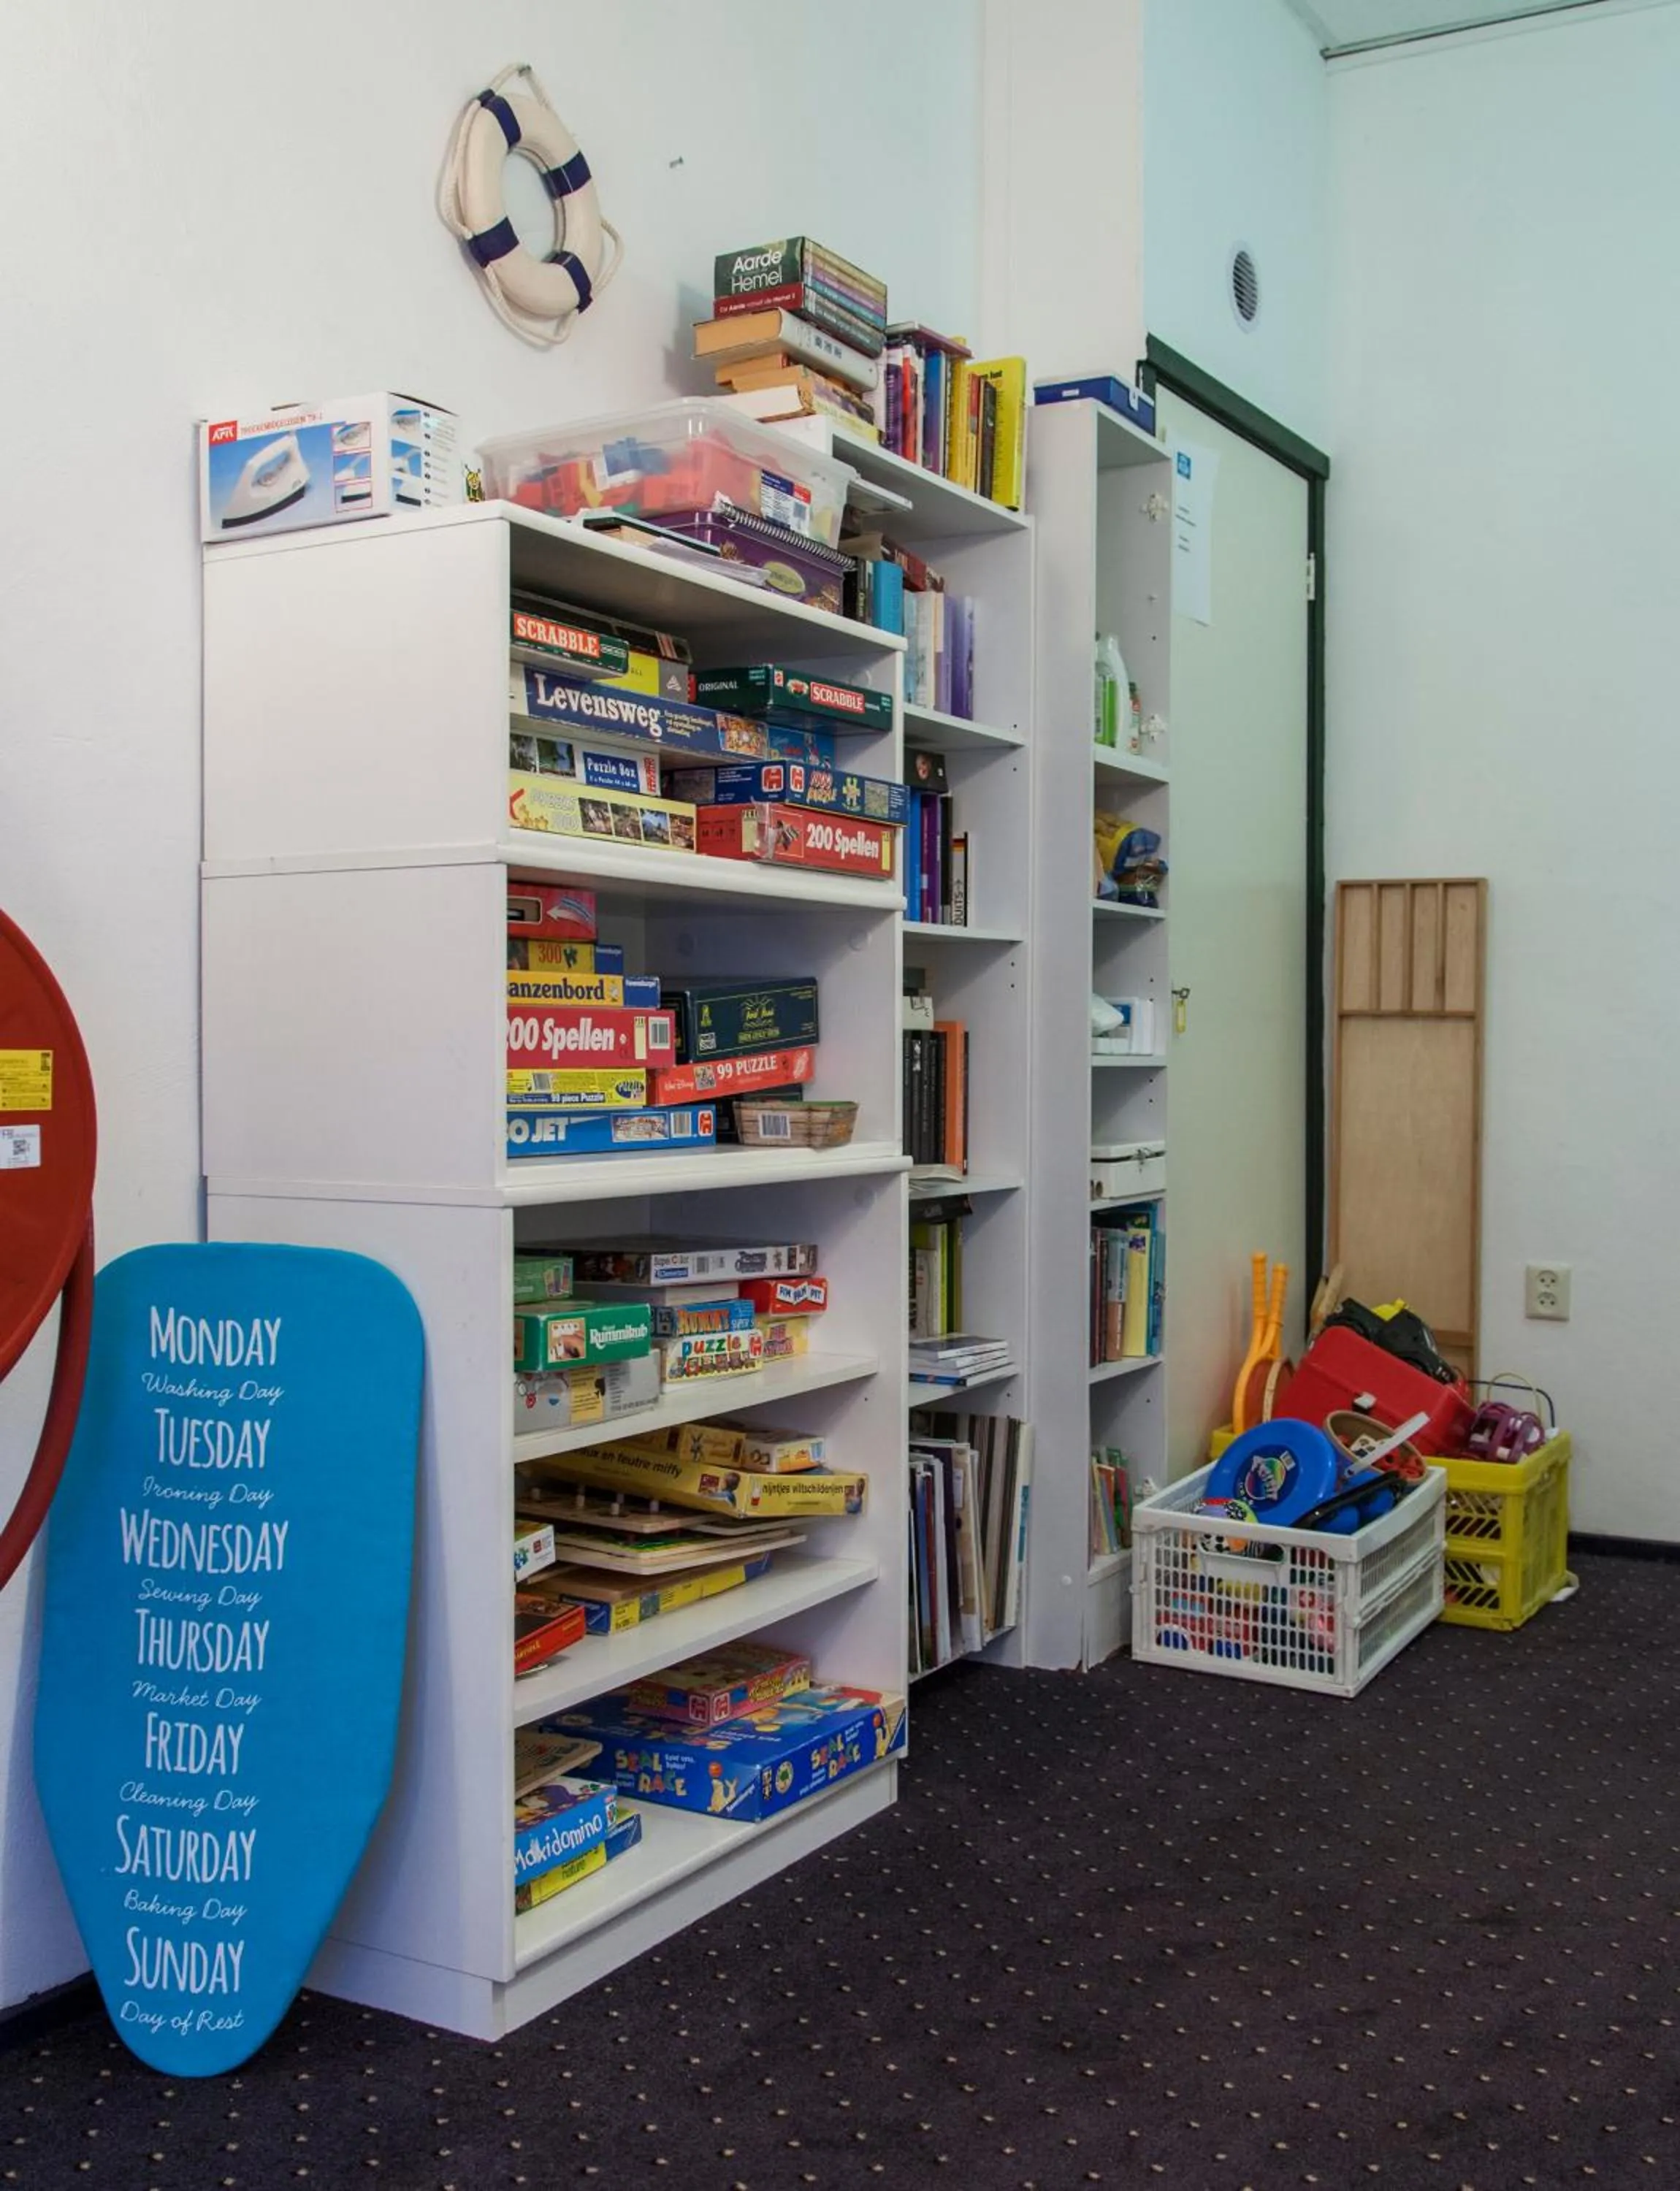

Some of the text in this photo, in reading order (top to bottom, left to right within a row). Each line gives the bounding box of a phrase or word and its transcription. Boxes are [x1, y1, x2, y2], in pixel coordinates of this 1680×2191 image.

[731, 264, 782, 294] Hemel
[733, 249, 782, 275] Aarde
[515, 617, 599, 657] SCRABBLE
[698, 680, 739, 693] ORIGINAL
[812, 686, 863, 712] SCRABBLE
[534, 673, 663, 738] Levensweg
[587, 757, 616, 776] Puzzle
[806, 822, 879, 860] 200 Spellen
[538, 944, 562, 964] 300
[508, 978, 605, 1000] anzenbord
[506, 1017, 615, 1060] 00 Spellen
[717, 1055, 777, 1079] 99 PUZZLE
[531, 1117, 569, 1143] JET
[150, 1305, 281, 1366] MONDAY
[589, 1324, 648, 1350] Rummikub
[681, 1335, 741, 1358] puzzle
[142, 1372, 285, 1407] Washing Day
[154, 1407, 271, 1469] TUESDAY
[652, 1461, 683, 1480] miffy
[142, 1475, 274, 1510] Ironing Day
[121, 1507, 289, 1574] WEDNESDAY
[138, 1578, 263, 1611] Sewing Day
[134, 1608, 270, 1672] THURSDAY
[132, 1680, 262, 1714] Market Day
[145, 1711, 245, 1775] FRIDAY
[615, 1748, 663, 1773] SEAL
[119, 1781, 260, 1818] Cleaning Day
[638, 1770, 687, 1796] RACE
[115, 1814, 256, 1884] SATURDAY
[124, 1889, 248, 1926] Baking Day
[124, 1926, 245, 1995] SUNDAY
[121, 2000, 245, 2036] Day of Rest
